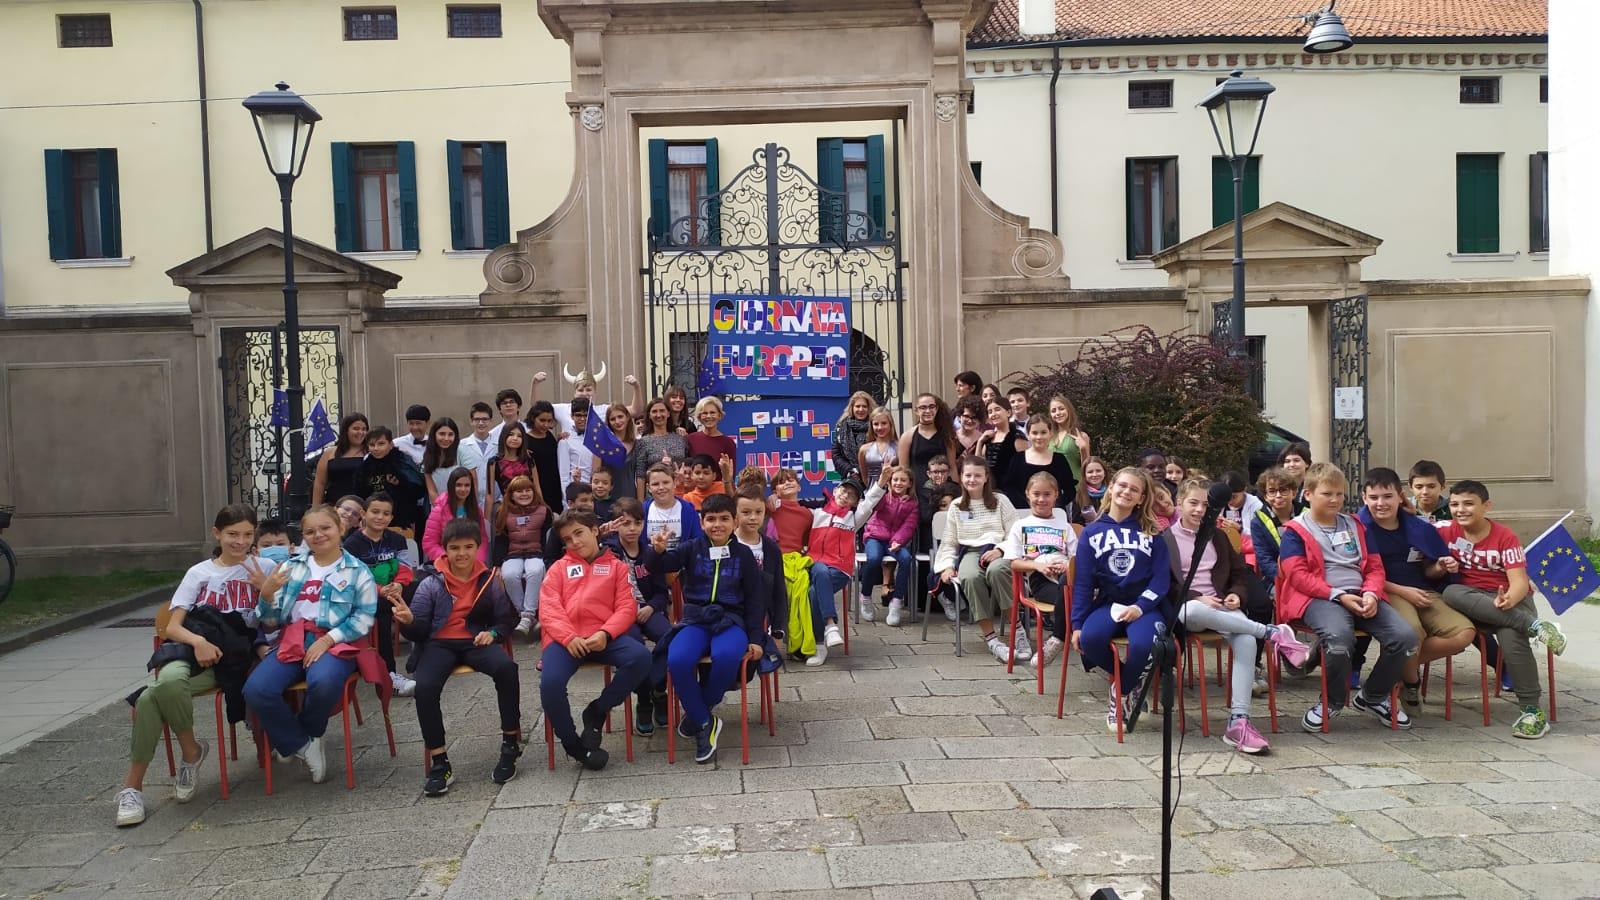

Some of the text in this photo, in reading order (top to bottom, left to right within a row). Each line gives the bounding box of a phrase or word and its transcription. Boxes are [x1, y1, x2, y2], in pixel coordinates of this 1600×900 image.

[713, 299, 848, 333] GIORNATA
[712, 344, 847, 378] EUROPEA
[772, 409, 795, 424] delle
[1088, 527, 1154, 559] YALE
